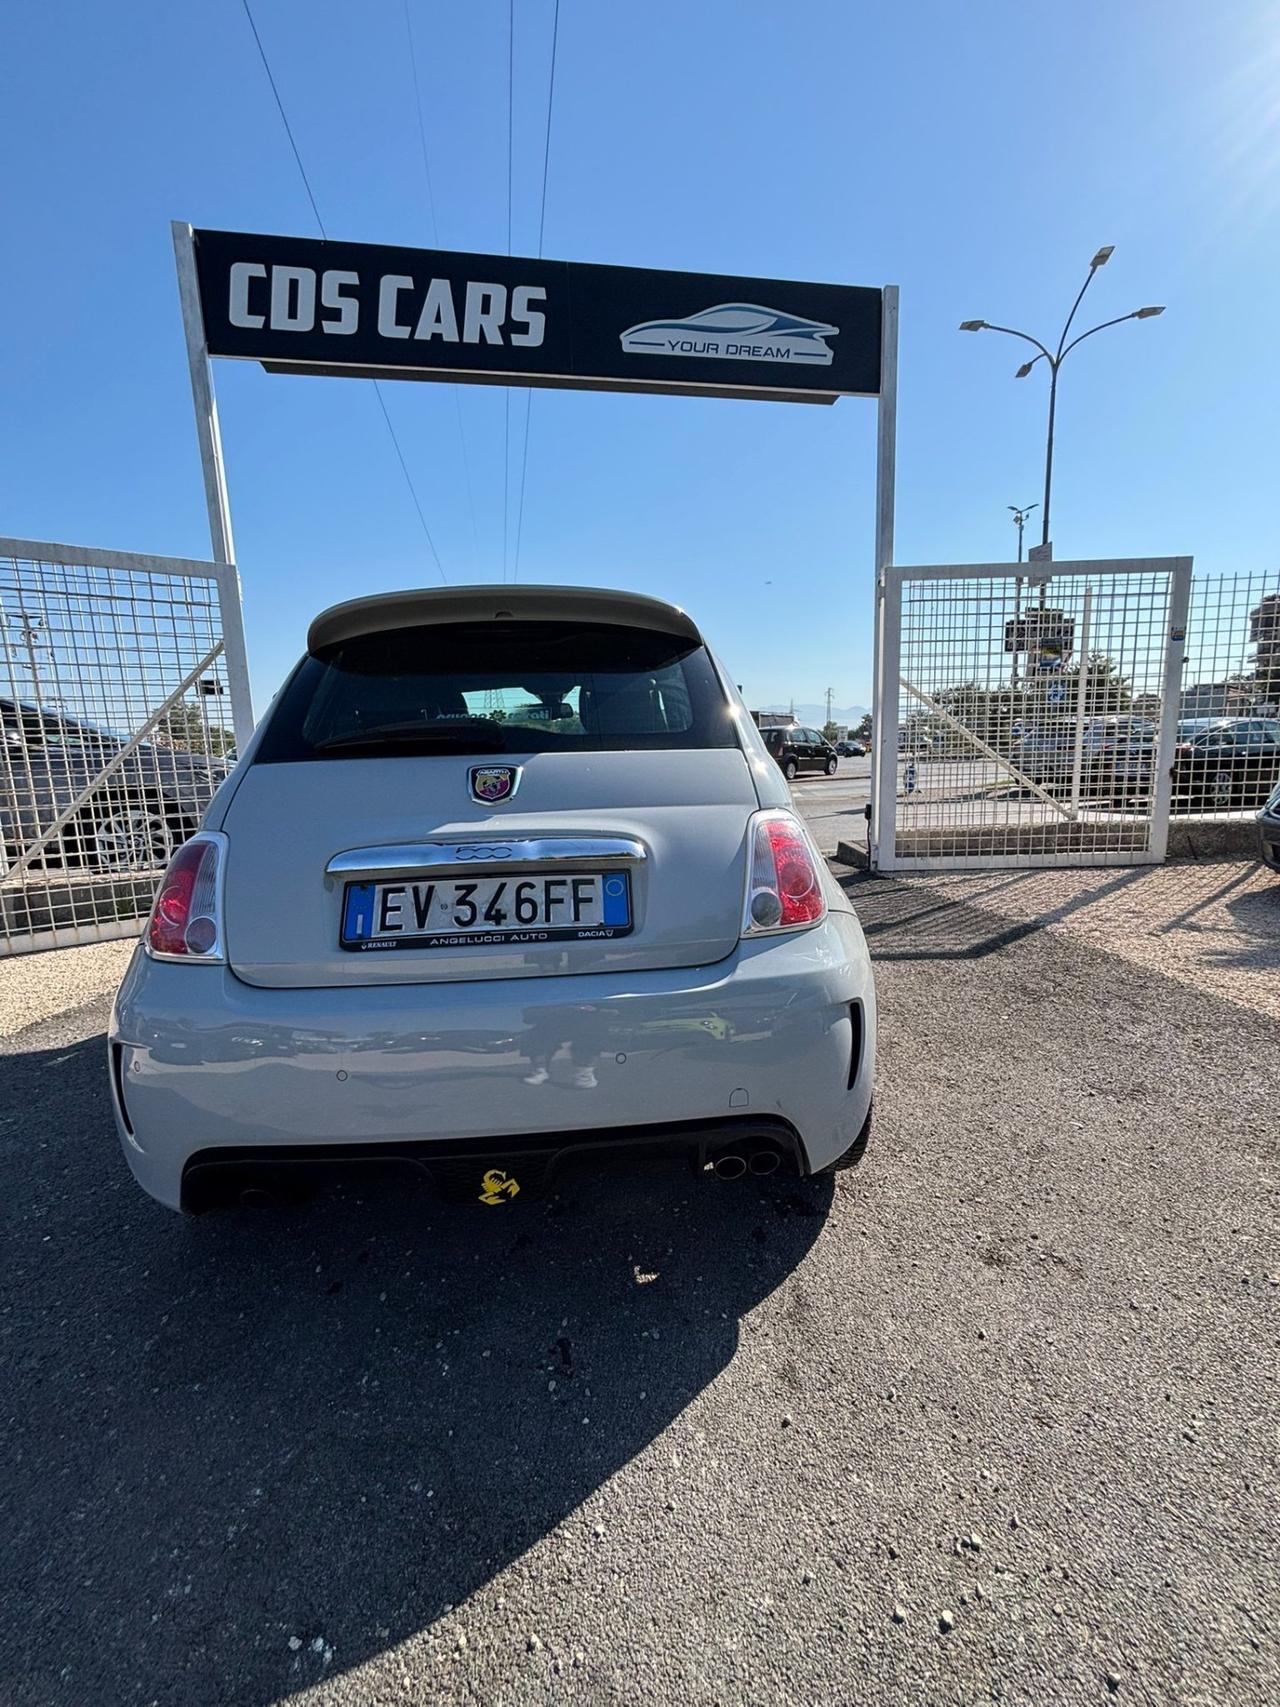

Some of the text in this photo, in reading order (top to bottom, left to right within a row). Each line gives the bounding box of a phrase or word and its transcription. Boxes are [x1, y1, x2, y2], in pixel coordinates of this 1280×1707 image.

[229, 262, 547, 347] CDS CARS
[667, 340, 790, 359] YOUR DREAM
[456, 846, 512, 860] 500
[380, 879, 595, 931] EV 346FF
[367, 941, 397, 949] RENAULT
[430, 932, 548, 946] ANGELUCCI AUTO
